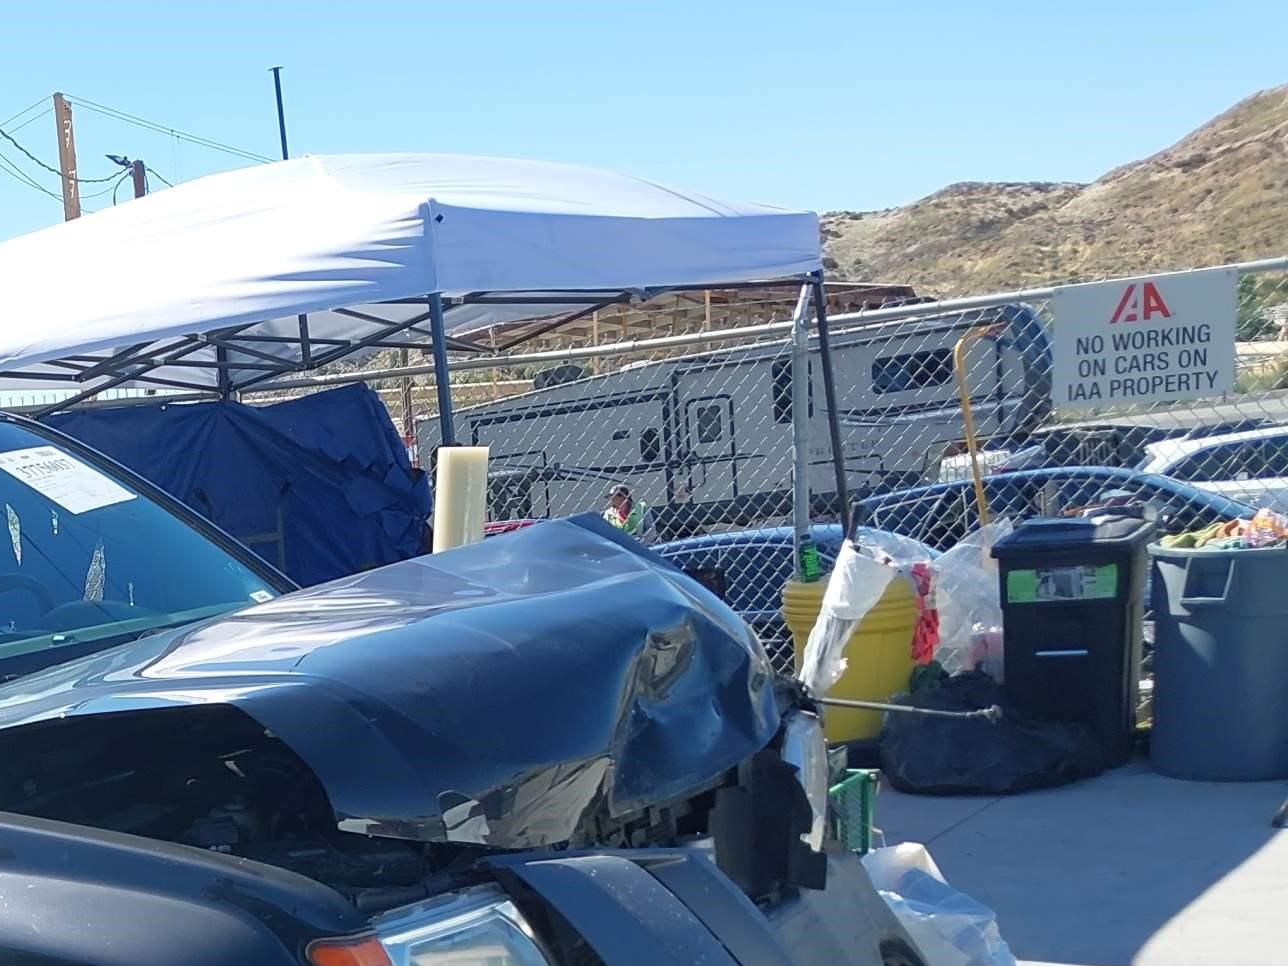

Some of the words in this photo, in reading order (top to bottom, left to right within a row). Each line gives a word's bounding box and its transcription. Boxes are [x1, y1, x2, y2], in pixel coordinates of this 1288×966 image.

[1076, 334, 1104, 355] NO
[1112, 324, 1211, 352] WORKING
[1078, 359, 1106, 378] ON
[1115, 352, 1170, 374] CARS
[1178, 348, 1208, 368] ON
[1068, 382, 1102, 401] IAA
[1110, 370, 1219, 398] PROPERTY
